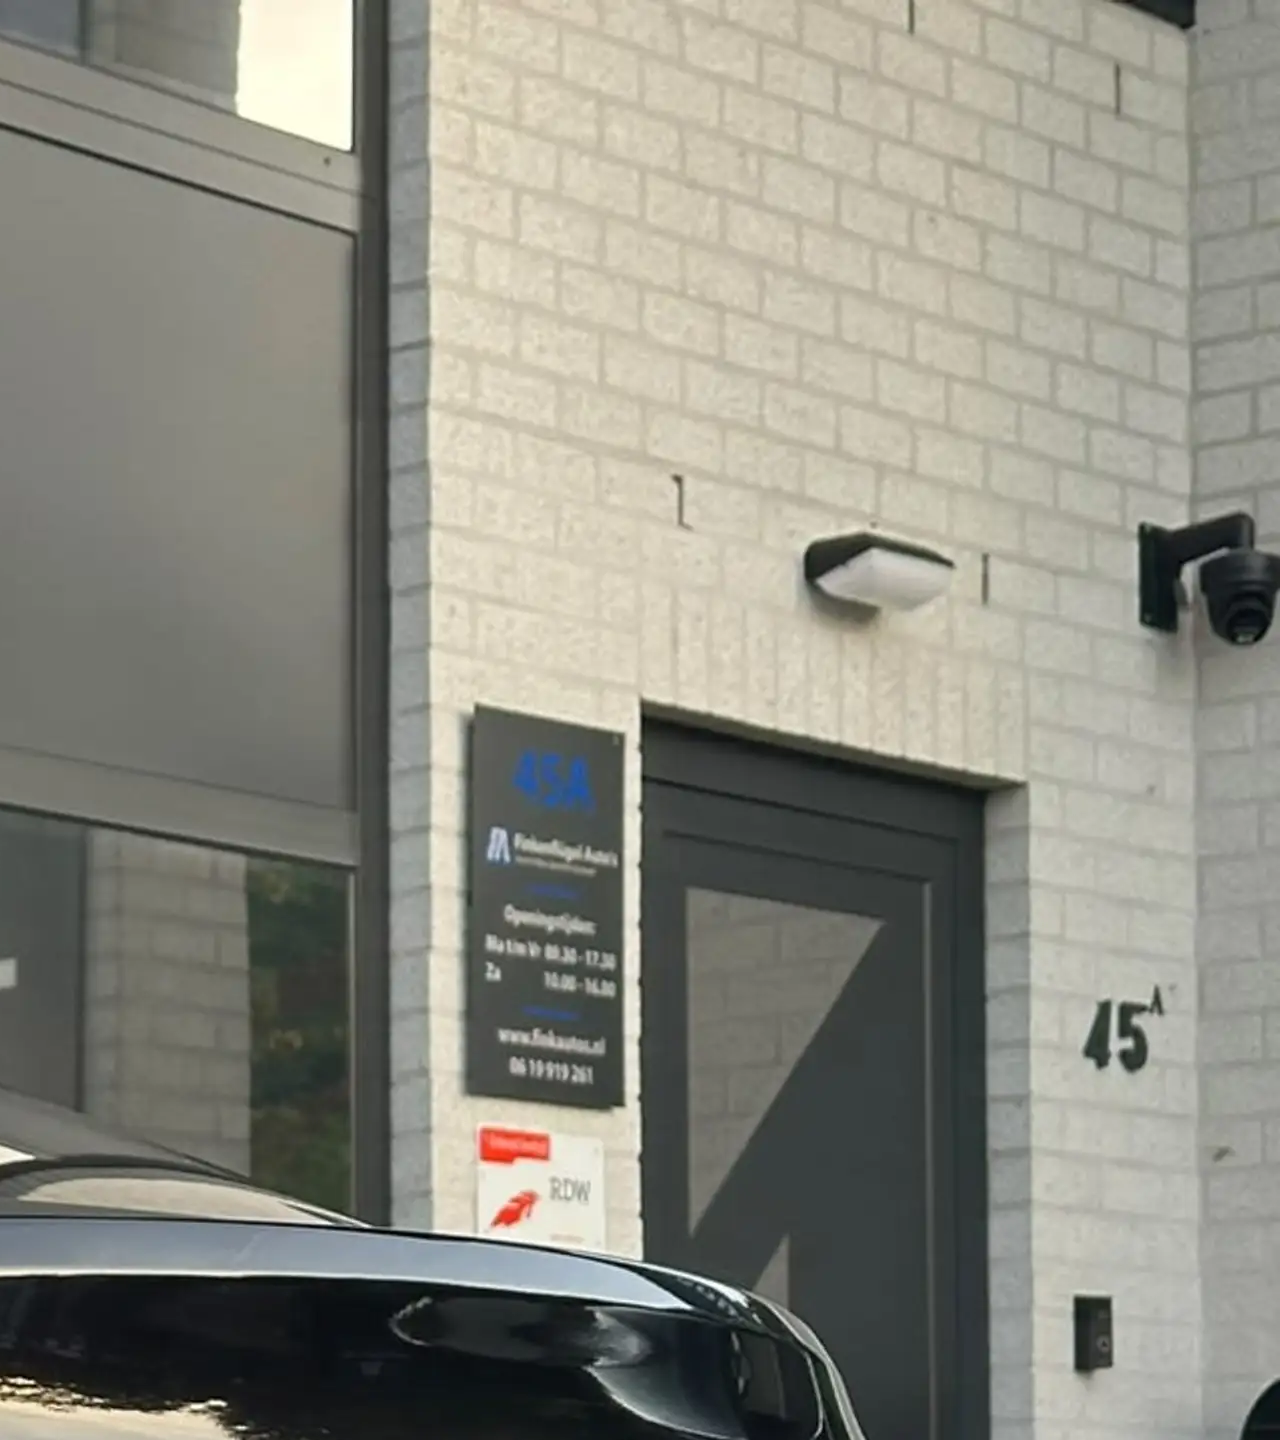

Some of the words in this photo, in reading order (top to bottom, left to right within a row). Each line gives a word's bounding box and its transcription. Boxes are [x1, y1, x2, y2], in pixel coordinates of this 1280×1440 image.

[497, 1027, 607, 1058] www.finkautos.nl
[508, 1055, 527, 1077] 06
[548, 1176, 592, 1206] RDW
